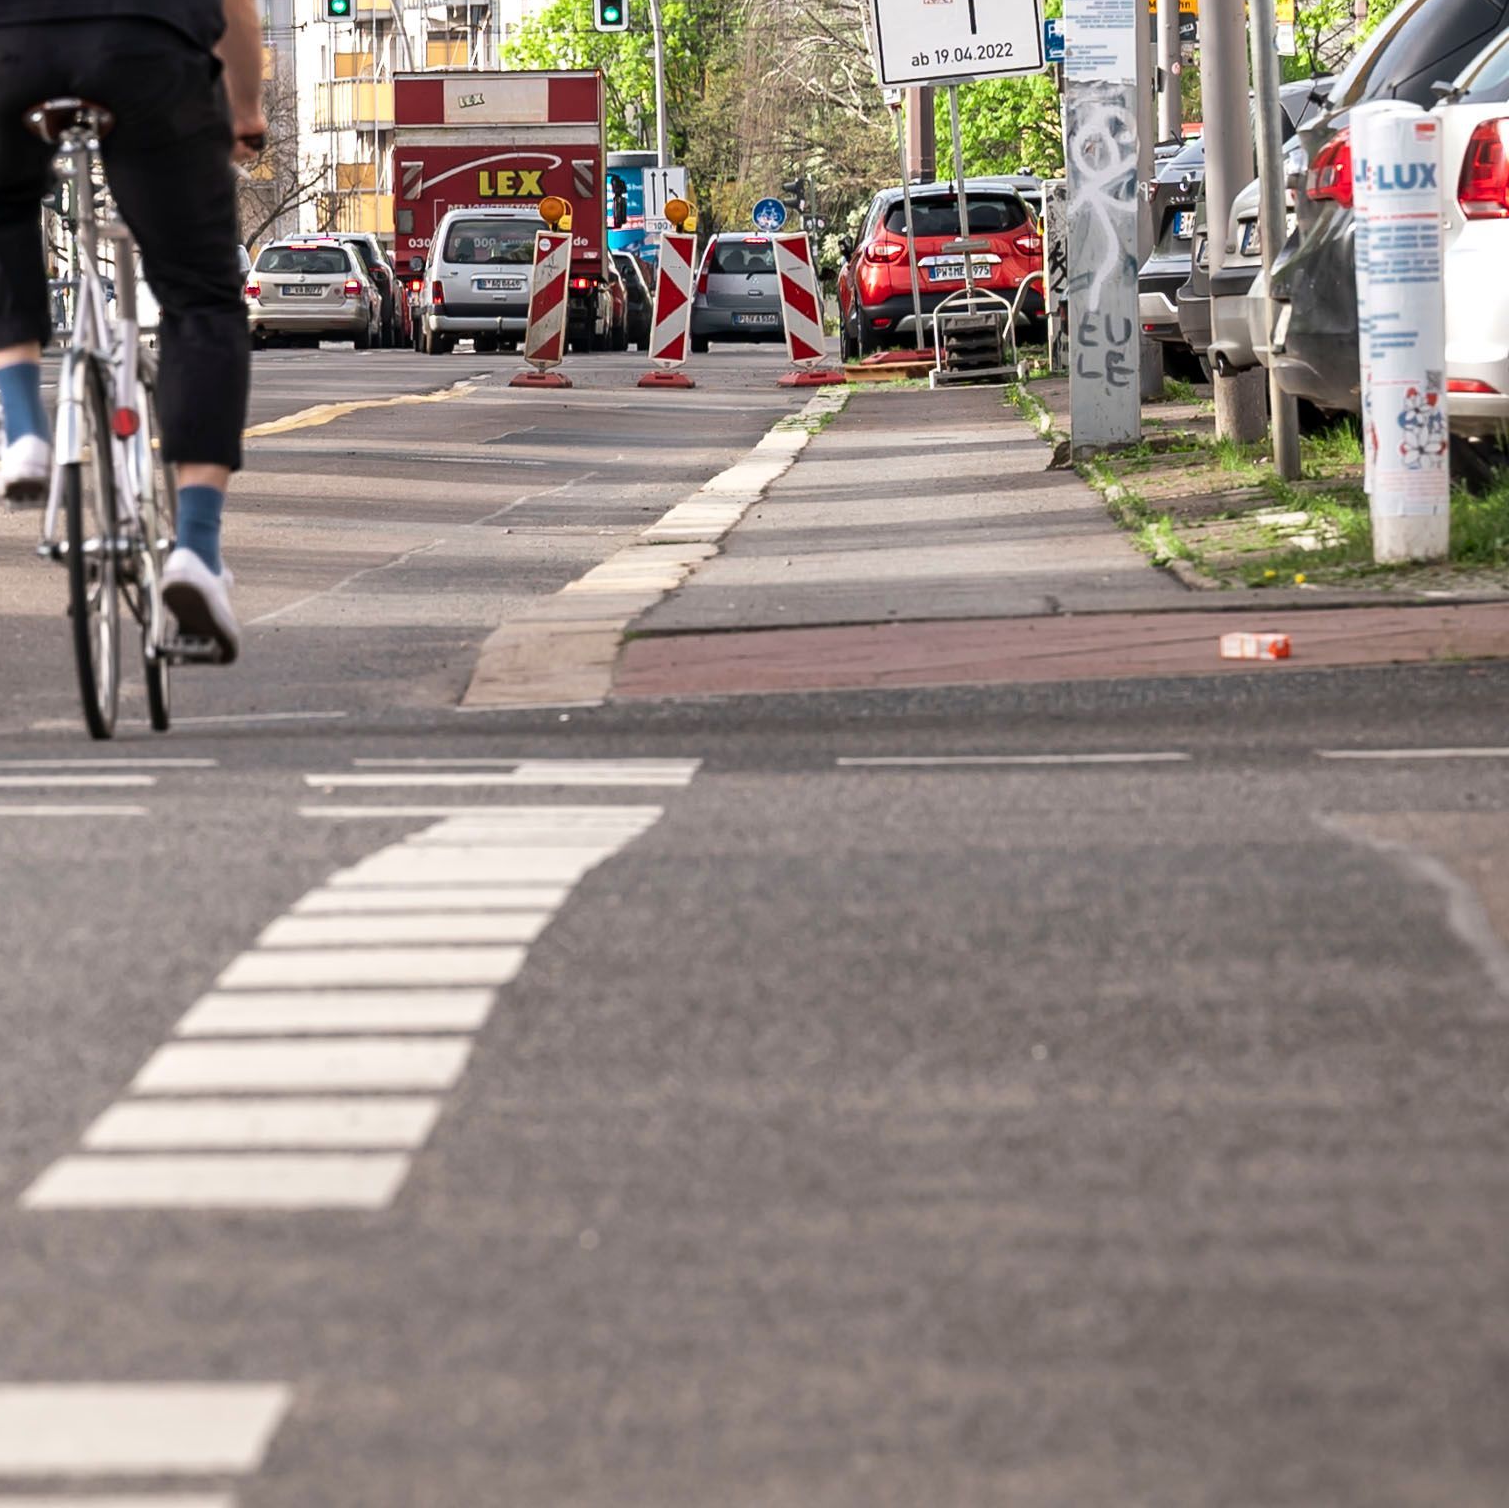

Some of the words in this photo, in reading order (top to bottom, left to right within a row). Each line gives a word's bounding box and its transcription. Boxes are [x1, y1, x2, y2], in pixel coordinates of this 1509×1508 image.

[911, 52, 930, 67] ab
[934, 42, 1013, 65] 19.04.2022
[458, 93, 485, 108] LEX
[479, 170, 544, 197] LEX
[936, 267, 947, 277] PW
[973, 265, 989, 275] 975
